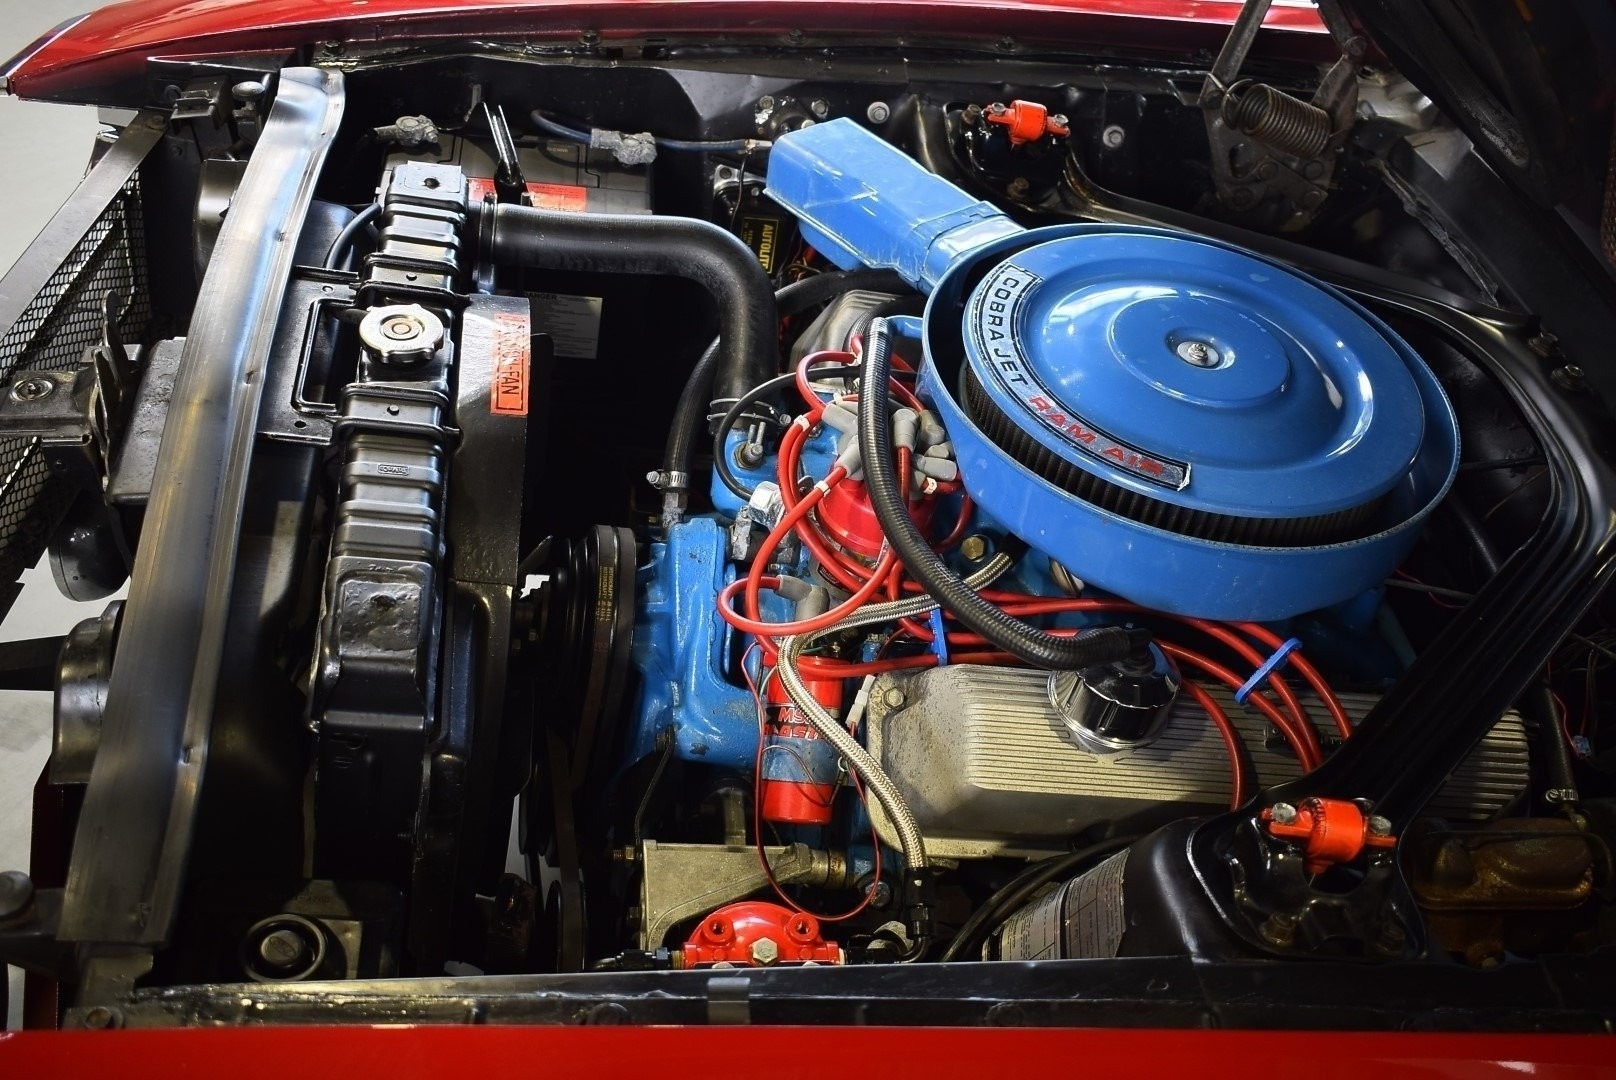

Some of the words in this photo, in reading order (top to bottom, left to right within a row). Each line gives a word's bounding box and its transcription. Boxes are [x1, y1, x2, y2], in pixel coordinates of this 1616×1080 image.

[987, 277, 1020, 341] COBRA
[991, 348, 1029, 386] JET
[1028, 395, 1097, 445] RAM
[1103, 446, 1164, 477] AIR
[778, 707, 811, 724] MS
